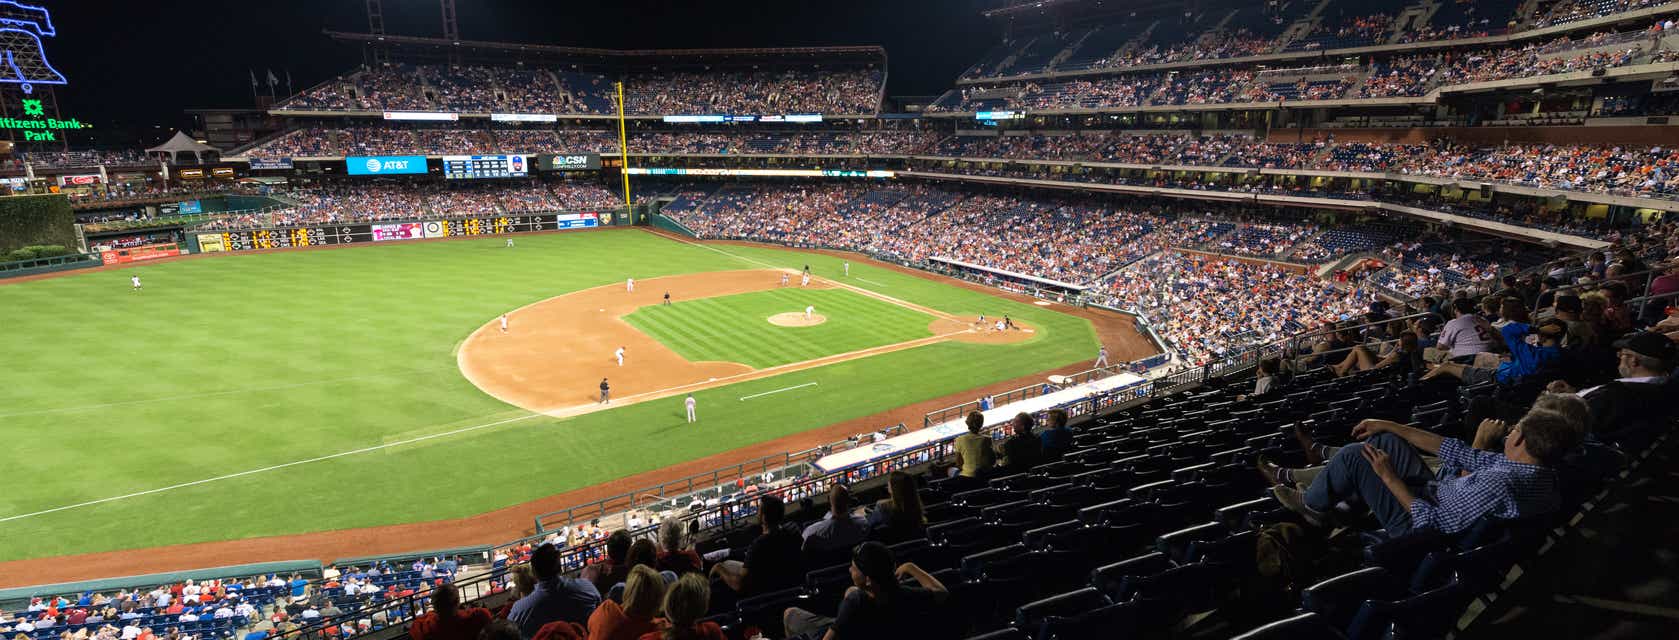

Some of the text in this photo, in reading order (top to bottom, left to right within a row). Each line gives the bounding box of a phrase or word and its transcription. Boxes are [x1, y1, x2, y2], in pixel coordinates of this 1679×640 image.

[48, 118, 81, 129] Bank
[24, 130, 56, 141] Park
[383, 160, 409, 170] AT&T
[566, 155, 588, 165] CSN
